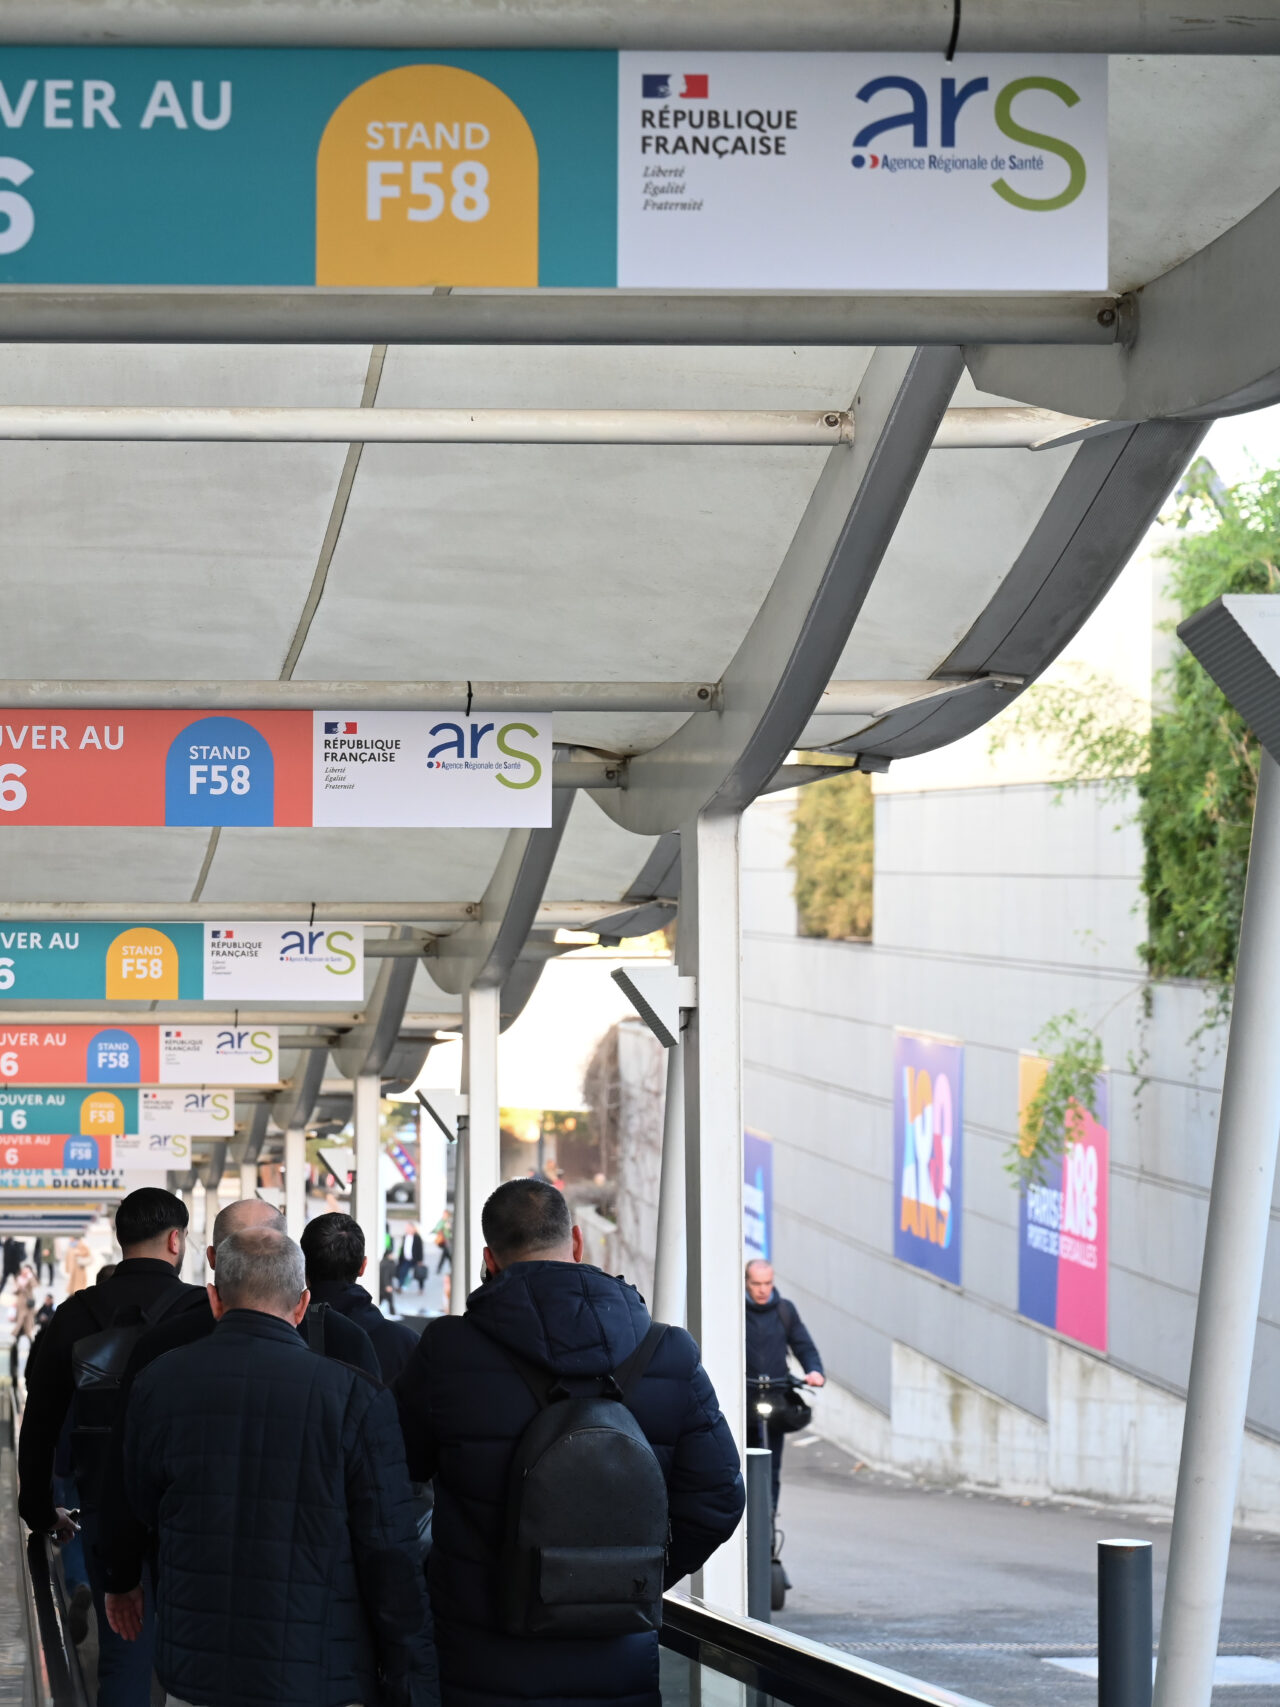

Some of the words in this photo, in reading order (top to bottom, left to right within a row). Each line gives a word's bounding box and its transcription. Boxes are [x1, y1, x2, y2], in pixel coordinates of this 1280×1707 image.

[140, 80, 232, 130] AU
[641, 105, 798, 132] RÉPUBLIQUE
[366, 121, 490, 150] STAND
[641, 136, 787, 159] FRANÇAISE
[852, 76, 1087, 212] ars
[643, 165, 684, 178] Liberté
[881, 154, 925, 173] Agence
[929, 155, 987, 173] Régionale
[990, 155, 1006, 170] de
[1009, 154, 1044, 171] Santé
[366, 160, 490, 222] F58
[643, 181, 685, 196] Égalité
[643, 198, 703, 212] Fraternité
[78, 725, 124, 750] AU
[324, 737, 401, 752] RÉPUBLIQUE
[189, 745, 250, 760] STAND
[324, 752, 396, 765] FRANÇAISE
[427, 722, 542, 789] ars
[441, 761, 462, 771] Agence
[464, 761, 493, 771] Régionale
[495, 761, 503, 769] de
[504, 761, 521, 770] Santé
[189, 764, 251, 795] F58
[49, 933, 79, 949] AU
[212, 940, 262, 950] RÉPUBLIQUE
[122, 946, 162, 956] STAND
[212, 950, 258, 958] FRANÇAISE
[280, 930, 356, 975] ars
[122, 958, 162, 979] F58
[44, 1034, 66, 1046] AU
[98, 1042, 129, 1050] STAND
[216, 1032, 273, 1064] ars
[0, 1052, 18, 1076] 6
[98, 1053, 129, 1068] F58
[46, 1095, 65, 1106] AU
[185, 1093, 230, 1120] ars
[11, 1110, 27, 1129] 6
[36, 1136, 50, 1145] AU
[5, 1148, 18, 1164] 6
[27, 1179, 45, 1188] LA
